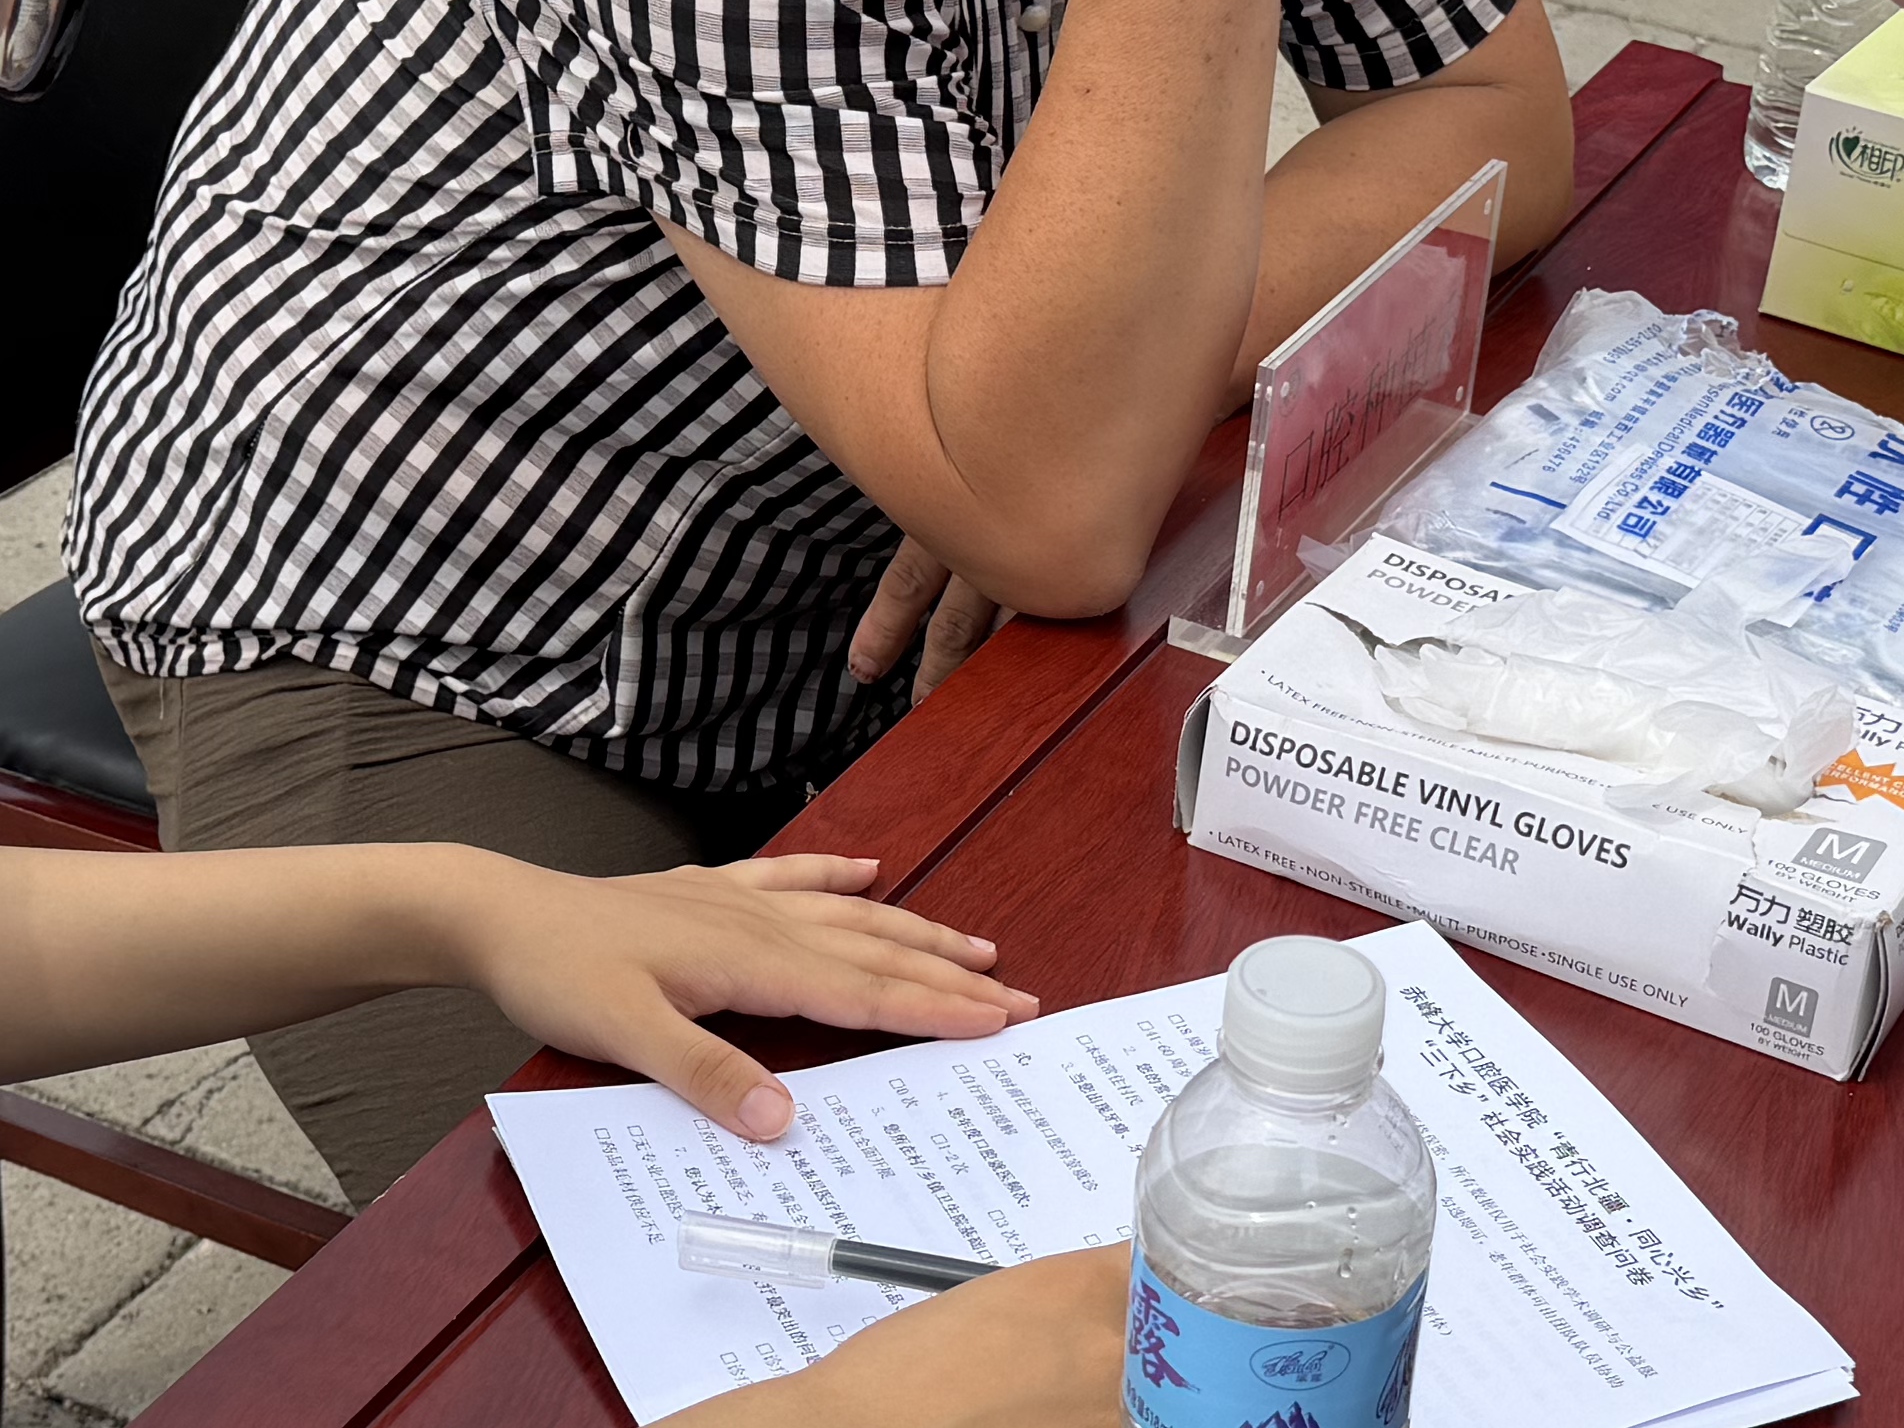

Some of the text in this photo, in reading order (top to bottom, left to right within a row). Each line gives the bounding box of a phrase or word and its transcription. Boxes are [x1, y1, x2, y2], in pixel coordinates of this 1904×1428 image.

[1617, 375, 1798, 539] 医疗器械有限公司
[1225, 755, 1521, 876] POWDER FREE CLEAR
[1228, 719, 1632, 870] DISPOSABLE VINYL GLOVES
[1799, 855, 1862, 880] MEDIUM
[1814, 831, 1870, 868] M
[1767, 858, 1882, 902] 100 GLOVES
[1216, 831, 1261, 858] LATEX
[1263, 849, 1298, 873] FREE
[1547, 950, 1604, 983] SINGLE
[1607, 971, 1640, 994] USE
[1642, 983, 1690, 1010] ONLY
[1726, 910, 1851, 966] Wally Plastic
[1793, 906, 1856, 946] 塑胶
[1775, 982, 1808, 1018] M
[1749, 1021, 1826, 1057] 100 GLOVES
